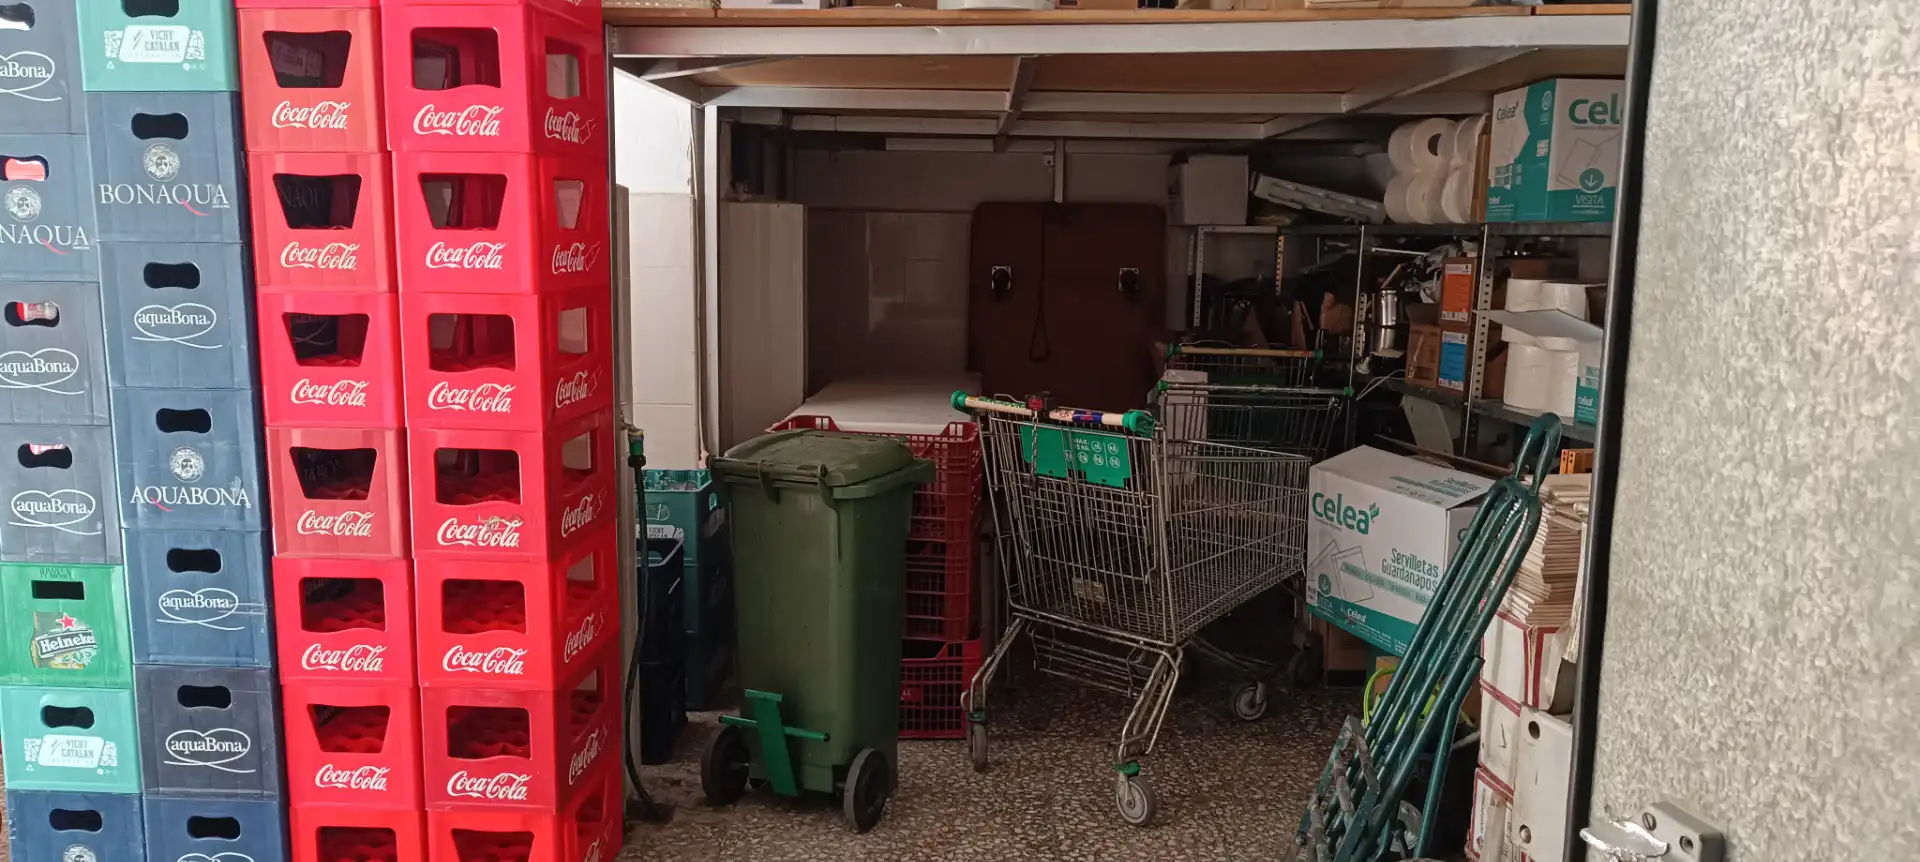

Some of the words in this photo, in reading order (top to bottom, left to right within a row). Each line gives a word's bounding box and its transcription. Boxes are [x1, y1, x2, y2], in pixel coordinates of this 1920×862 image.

[145, 41, 180, 51] CATALAN
[272, 101, 350, 129] Coca-Cola
[414, 104, 503, 136] Coca-Cola
[1569, 93, 1622, 125] Cel
[100, 184, 229, 215] BONAQUA
[280, 242, 360, 270] Coca-Cola
[426, 242, 505, 269] Coca-Cola
[291, 379, 369, 407] Coca-Cola
[428, 381, 516, 412] Coca-Cola
[130, 486, 251, 511] AQUABONA
[297, 510, 375, 536] Coca-Cola
[437, 517, 522, 547] Coca-Cola
[1382, 558, 1438, 593] Guardanapos
[1391, 547, 1439, 578] Servilletas
[302, 644, 386, 672] Coca-Cola
[443, 645, 527, 675] Coca-Cola
[315, 764, 390, 791] Coca-Cola
[447, 771, 531, 800] Coca-Cola
